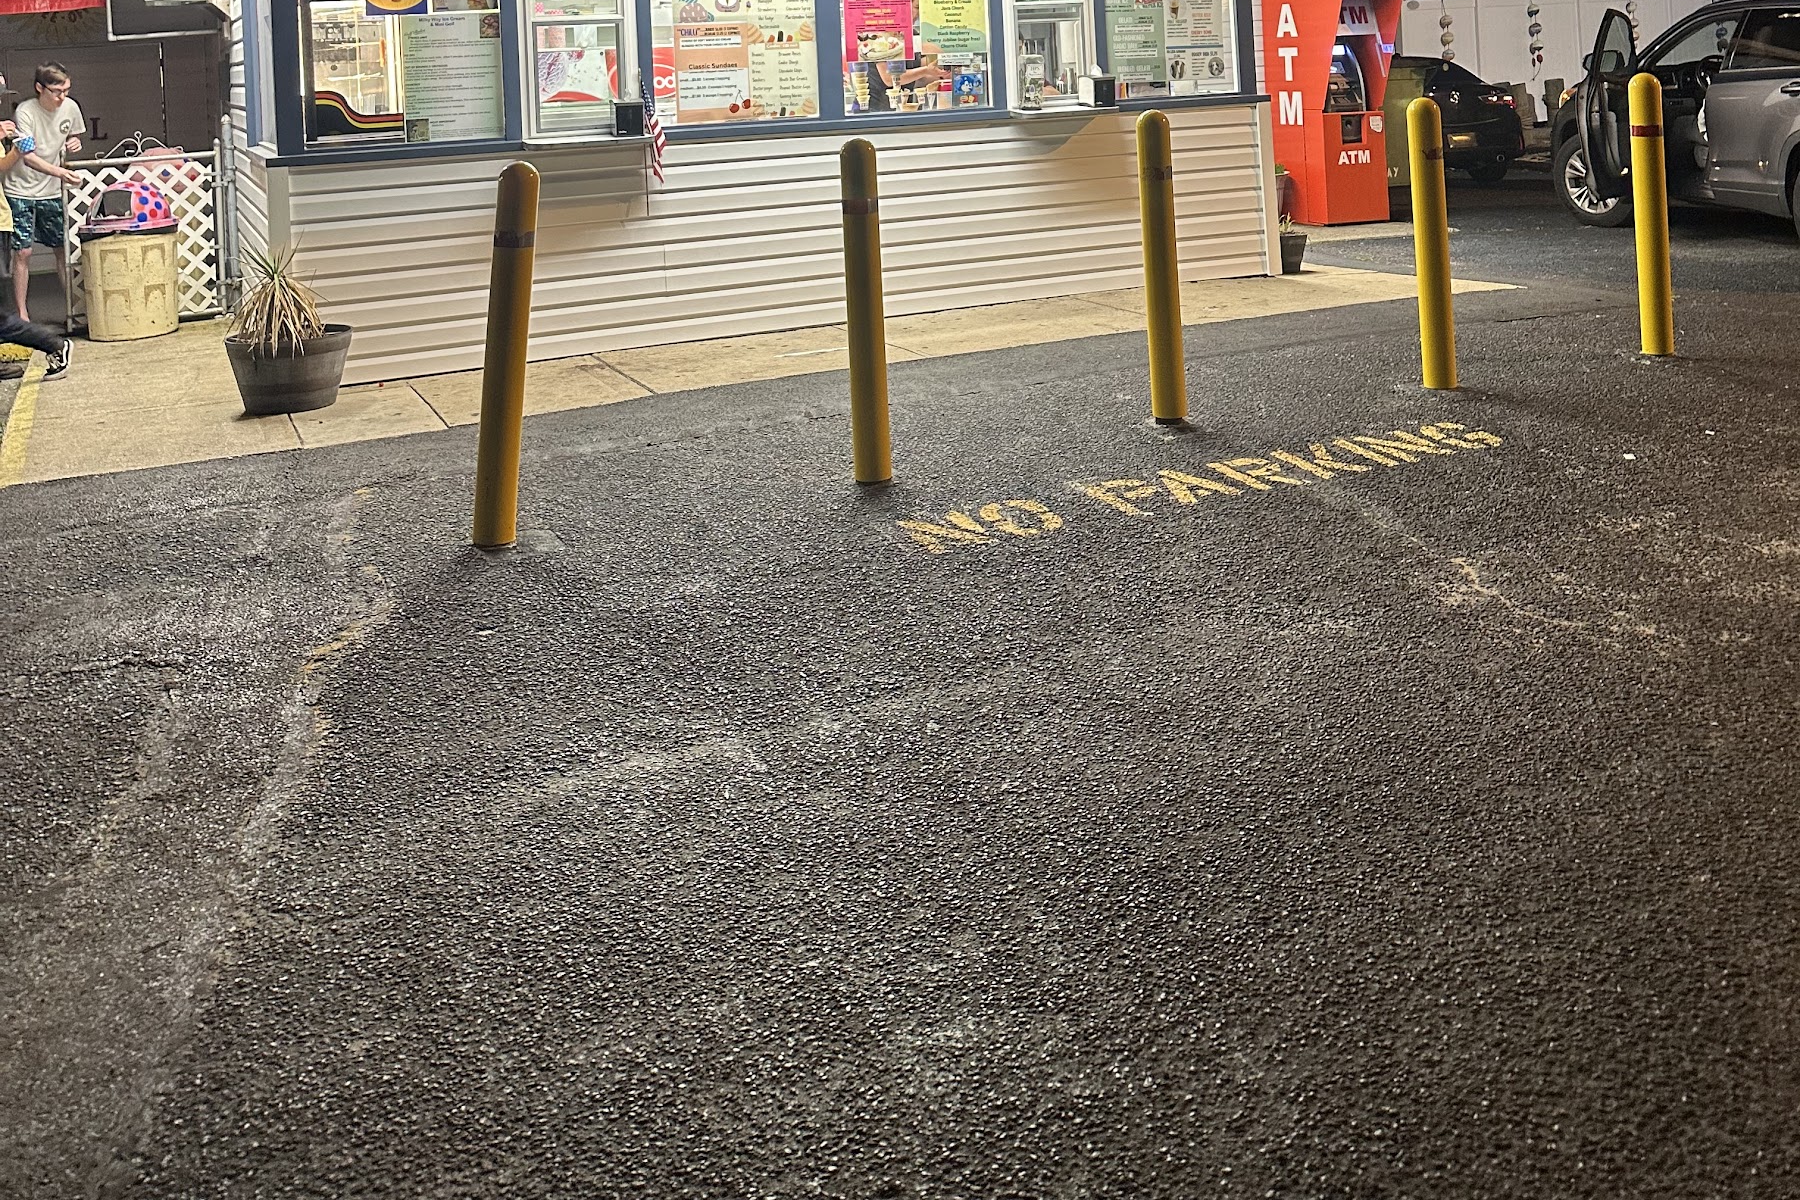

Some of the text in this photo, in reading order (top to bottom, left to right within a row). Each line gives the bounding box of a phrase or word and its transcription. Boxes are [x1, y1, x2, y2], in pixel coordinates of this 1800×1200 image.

[1276, 3, 1304, 126] ATM
[1338, 150, 1371, 165] ATM
[898, 421, 1503, 554] NO PARKING
